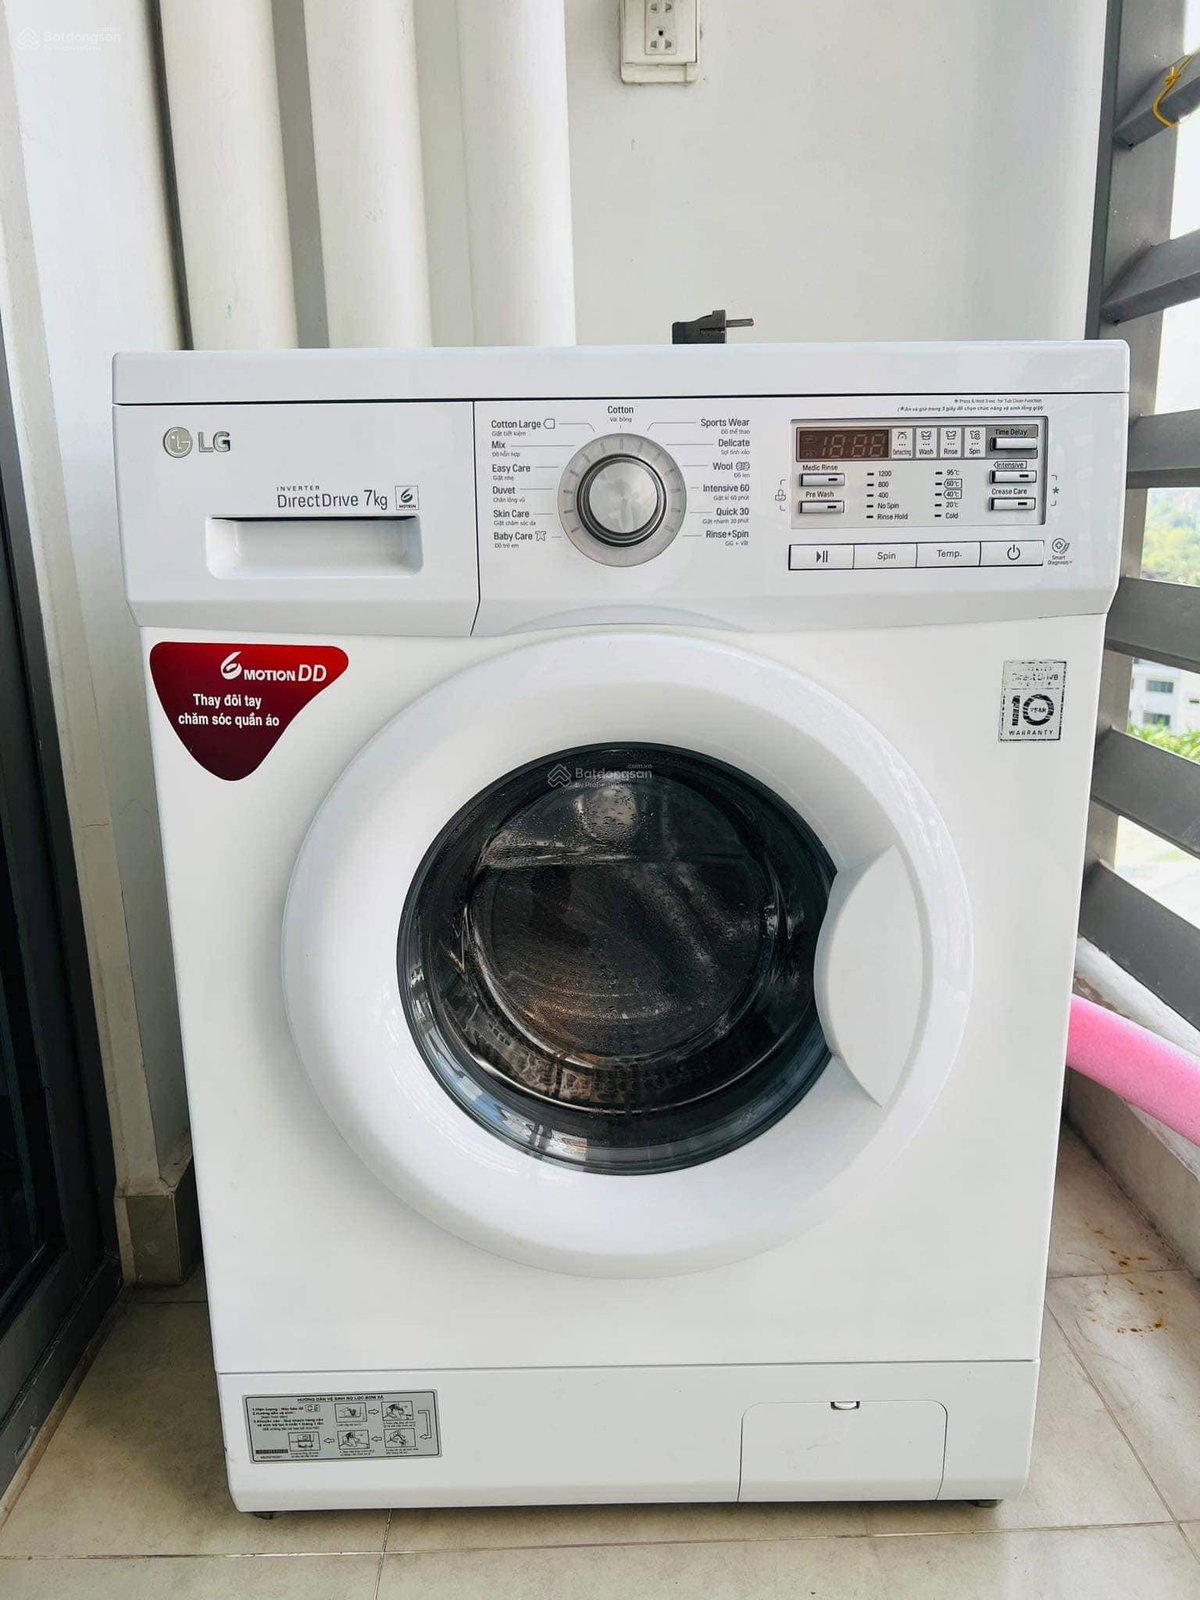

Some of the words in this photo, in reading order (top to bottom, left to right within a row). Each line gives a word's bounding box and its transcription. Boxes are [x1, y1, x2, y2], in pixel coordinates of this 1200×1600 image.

[607, 405, 634, 414] Cotton
[491, 420, 517, 428] Cotton
[519, 420, 541, 430] Large
[701, 418, 727, 428] Sports
[728, 418, 750, 427] Wear
[198, 431, 230, 452] LG
[491, 441, 506, 449] Mix
[718, 438, 750, 447] Delicate
[492, 464, 511, 473] Easy
[512, 464, 531, 472] Care
[712, 462, 733, 470] Wool
[492, 486, 515, 494] Duvet
[703, 484, 739, 492] Intensive
[740, 484, 750, 492] 60
[364, 489, 388, 510] 7kg
[493, 510, 510, 518] Skin
[511, 510, 530, 518] Care
[716, 507, 738, 516] Quick
[739, 507, 749, 515] 30
[493, 532, 513, 541] Baby
[514, 532, 533, 540] Care
[706, 530, 749, 539] Rinse+Spin
[877, 550, 896, 560] Spin
[936, 549, 962, 560] Temp.
[220, 651, 242, 680] 6
[244, 669, 296, 682] MOTION
[298, 664, 327, 682] DD
[193, 693, 221, 709] Thay
[244, 695, 262, 710] tay
[1012, 694, 1054, 726] 10
[178, 712, 209, 725] chăm
[212, 712, 232, 725] sóc
[235, 712, 262, 729] quần
[266, 713, 280, 726] áo
